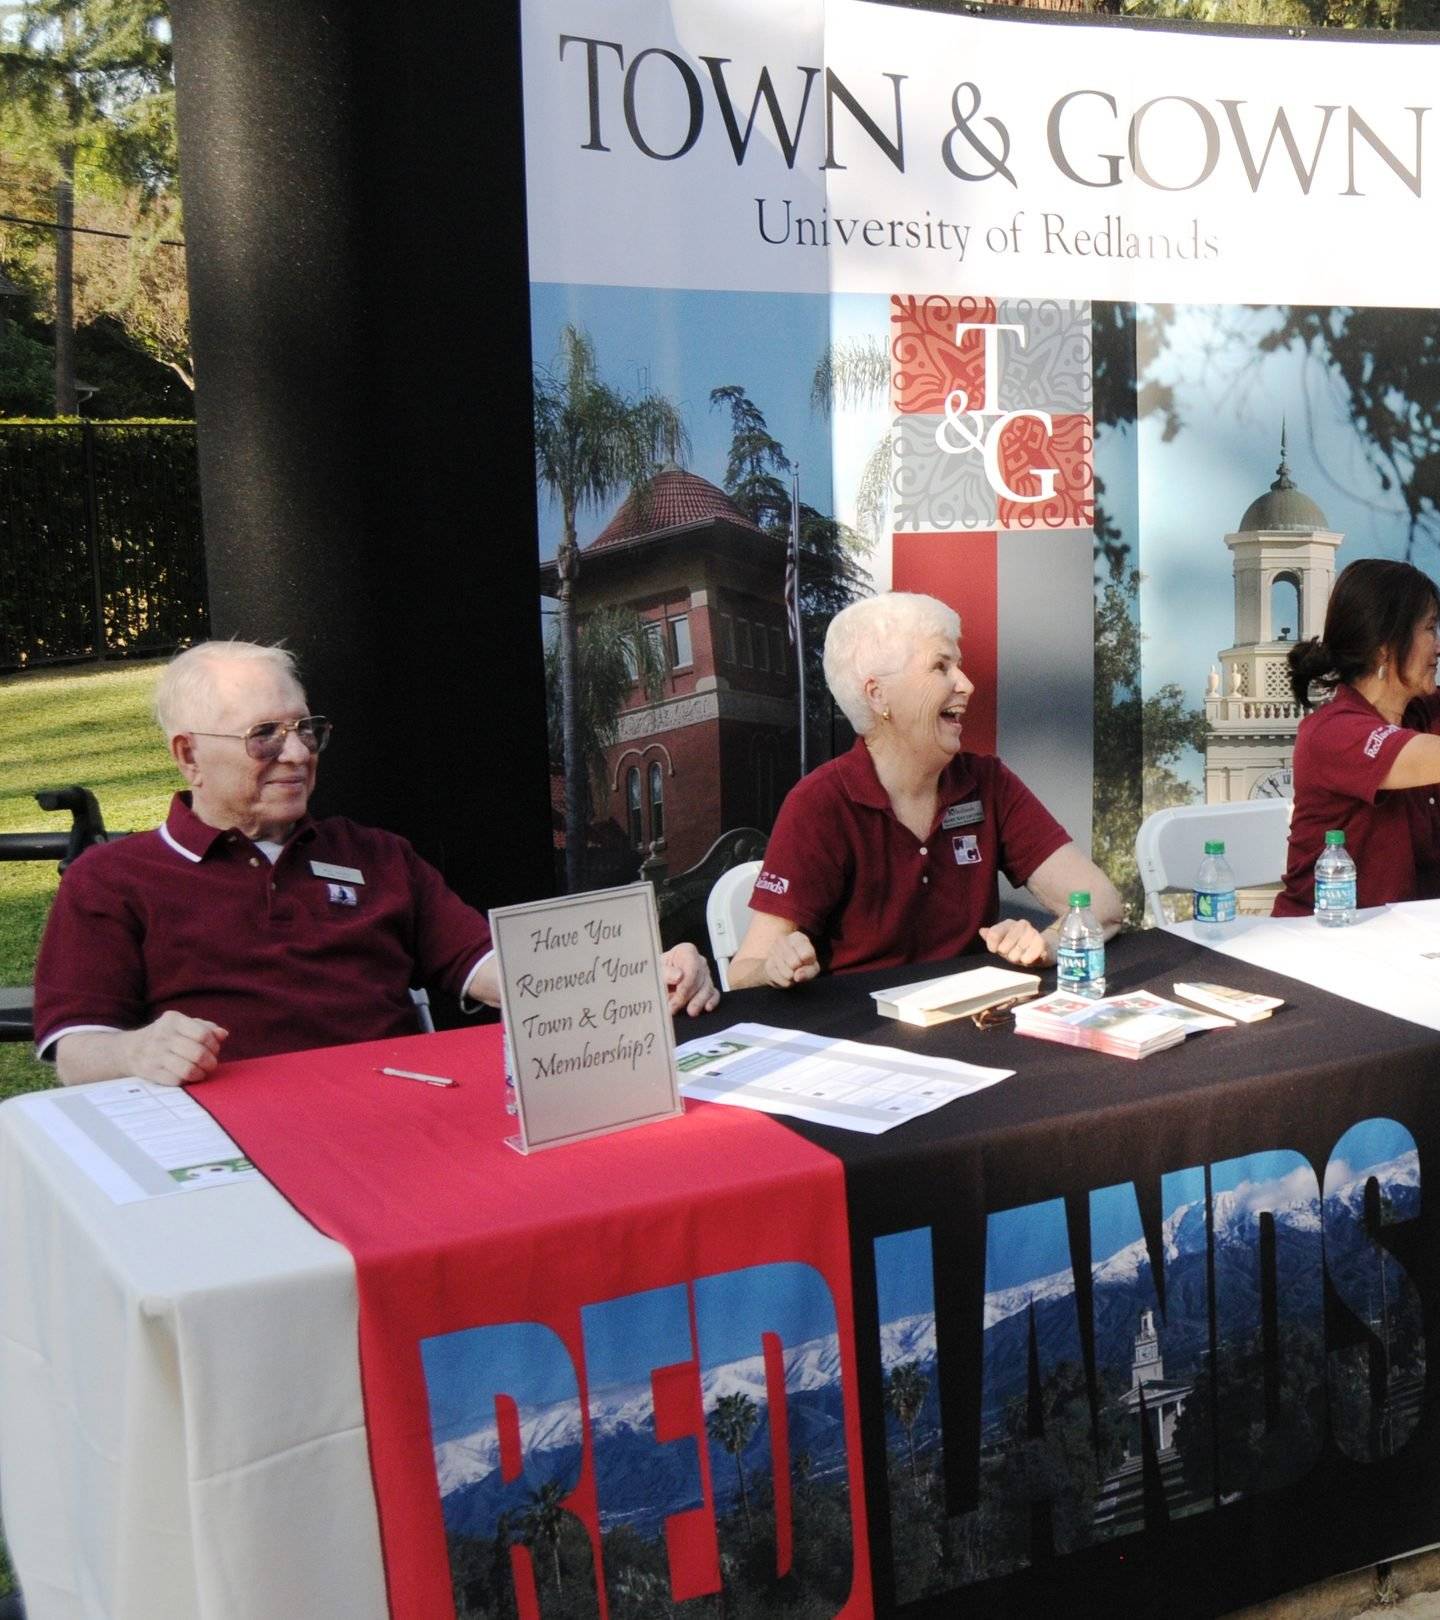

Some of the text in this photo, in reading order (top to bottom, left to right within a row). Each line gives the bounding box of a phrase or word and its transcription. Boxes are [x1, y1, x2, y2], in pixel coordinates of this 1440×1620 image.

[559, 34, 1432, 198] TOWN & GOWN
[754, 198, 1219, 263] University of Redlands
[530, 920, 622, 952] Have You
[516, 956, 648, 998] Renewed Your
[522, 999, 652, 1038] Town & Gown
[532, 1032, 655, 1080] Membership?
